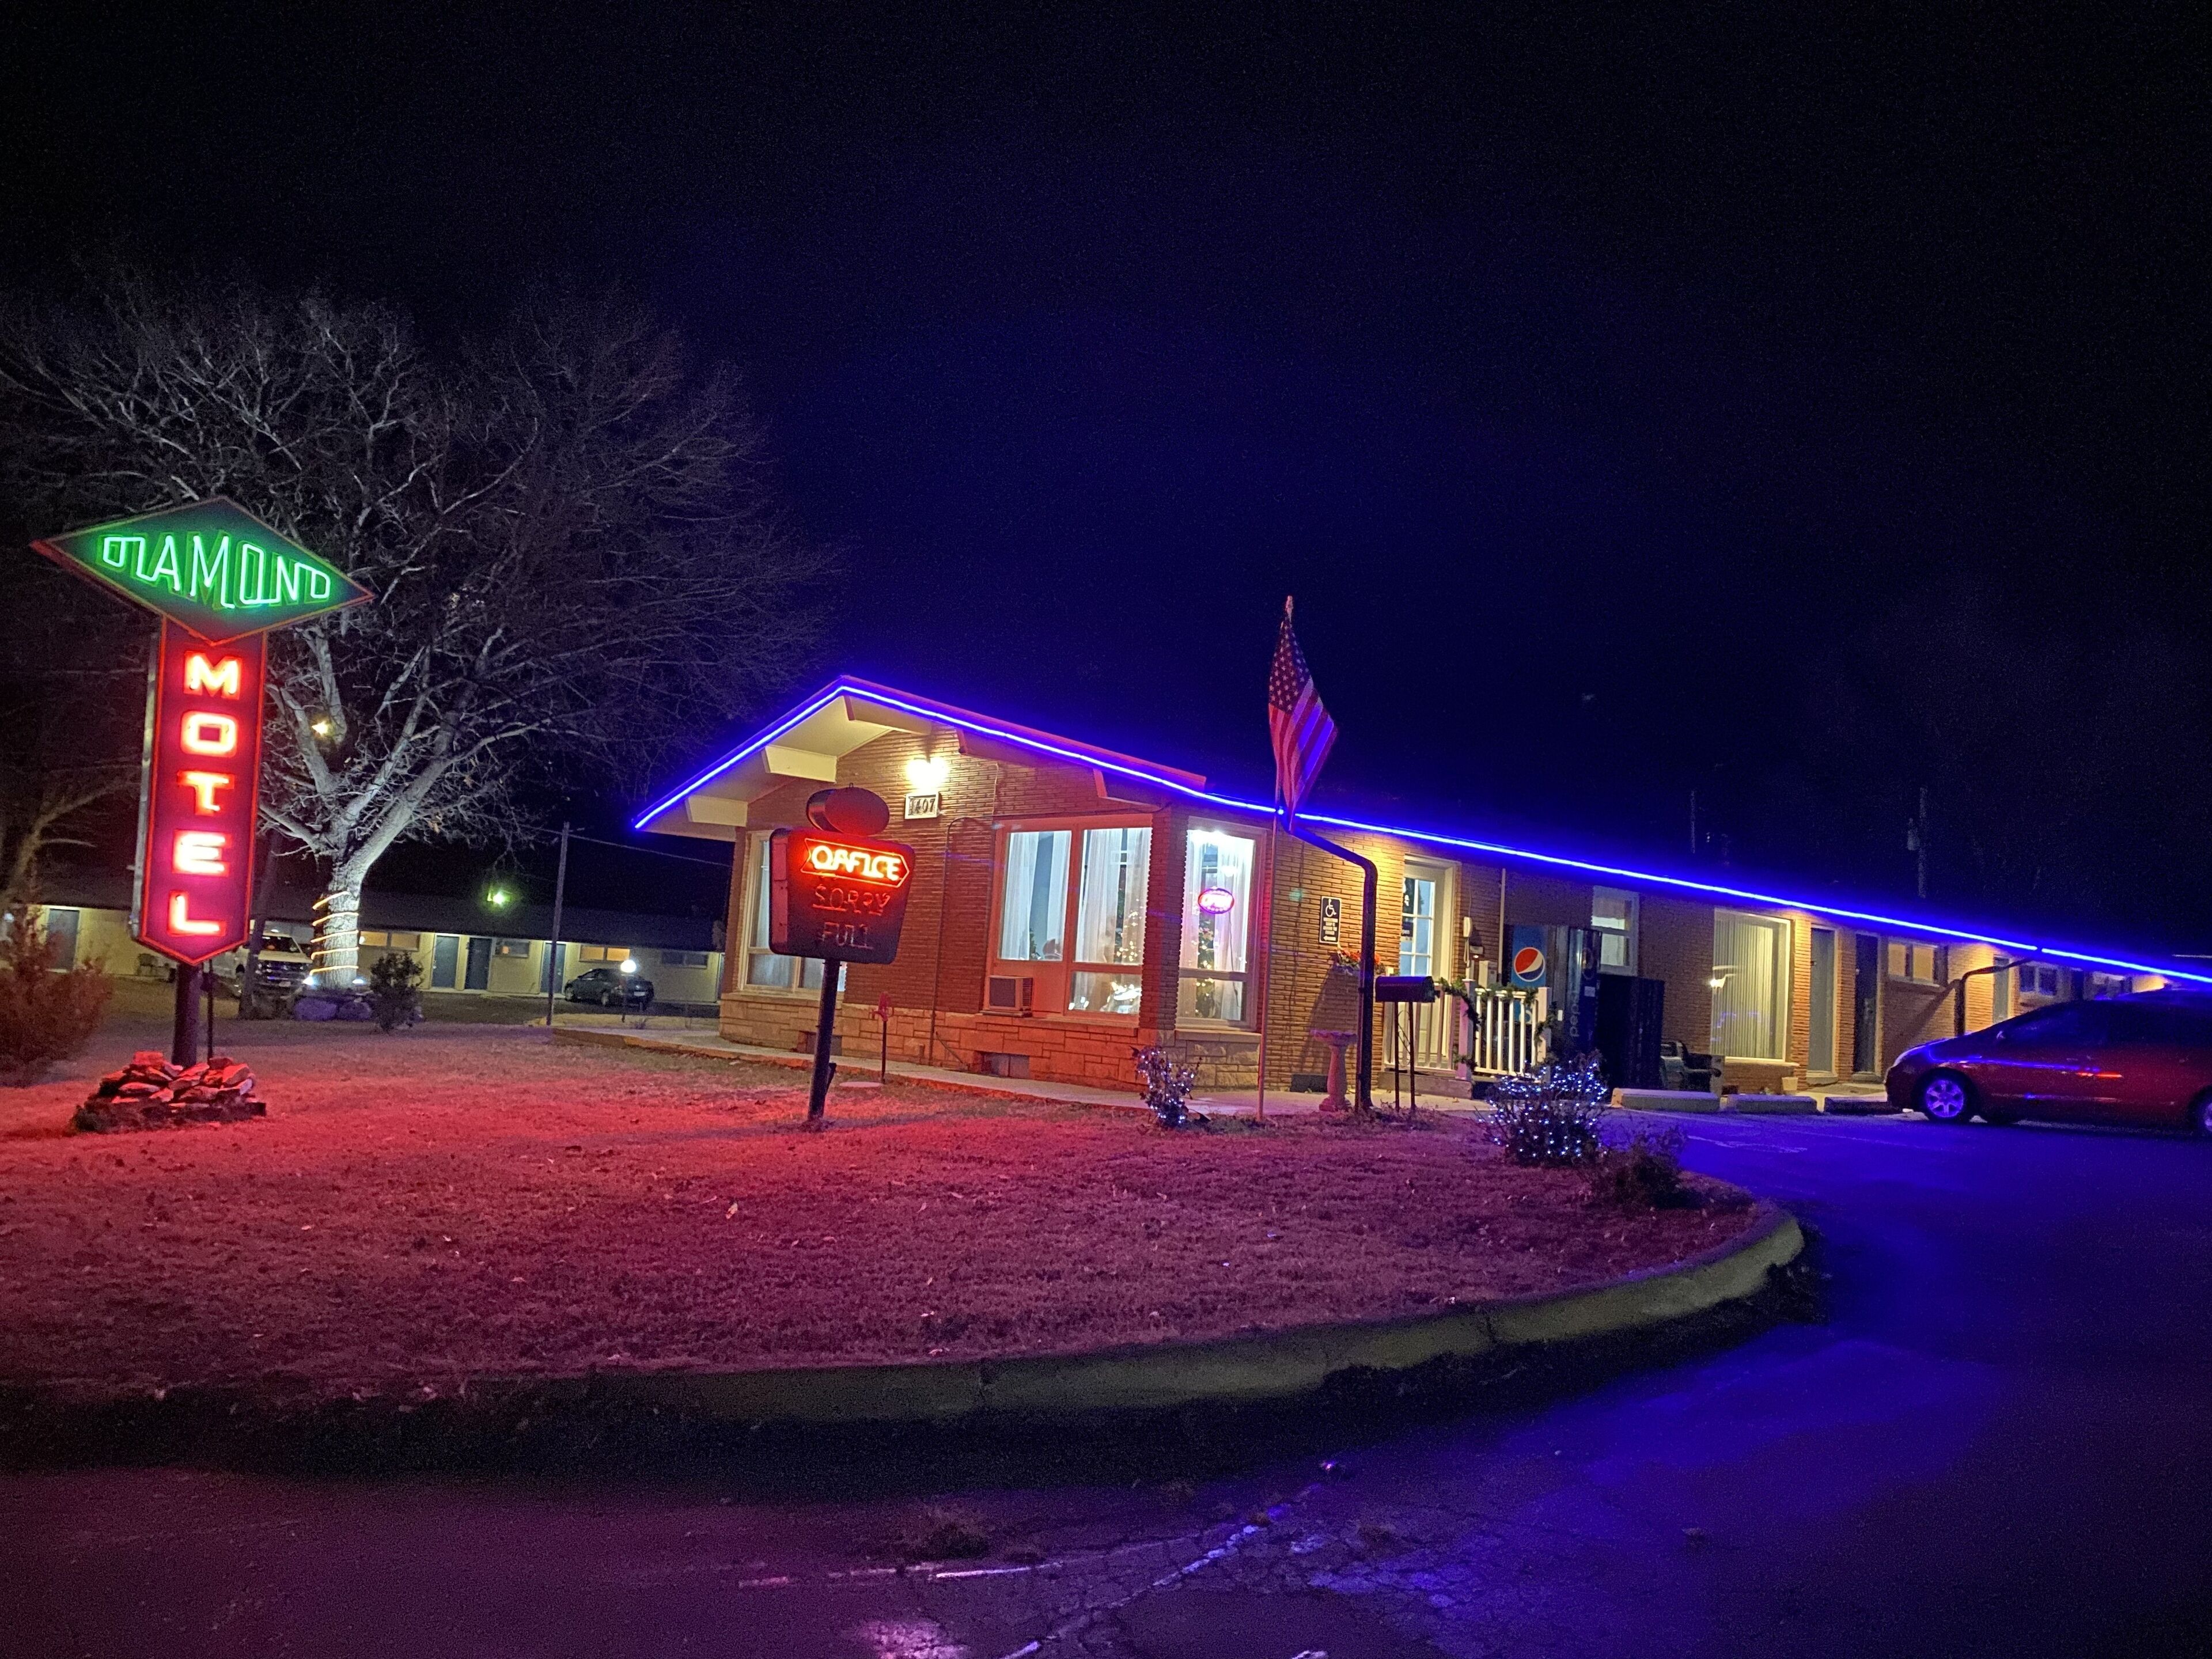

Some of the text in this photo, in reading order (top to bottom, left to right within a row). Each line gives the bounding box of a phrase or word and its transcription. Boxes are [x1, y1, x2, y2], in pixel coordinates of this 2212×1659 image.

[97, 530, 332, 609] DIAMOND
[168, 650, 242, 936] MOTEL
[811, 846, 901, 881] OFFICE
[812, 885, 891, 916] SORRY
